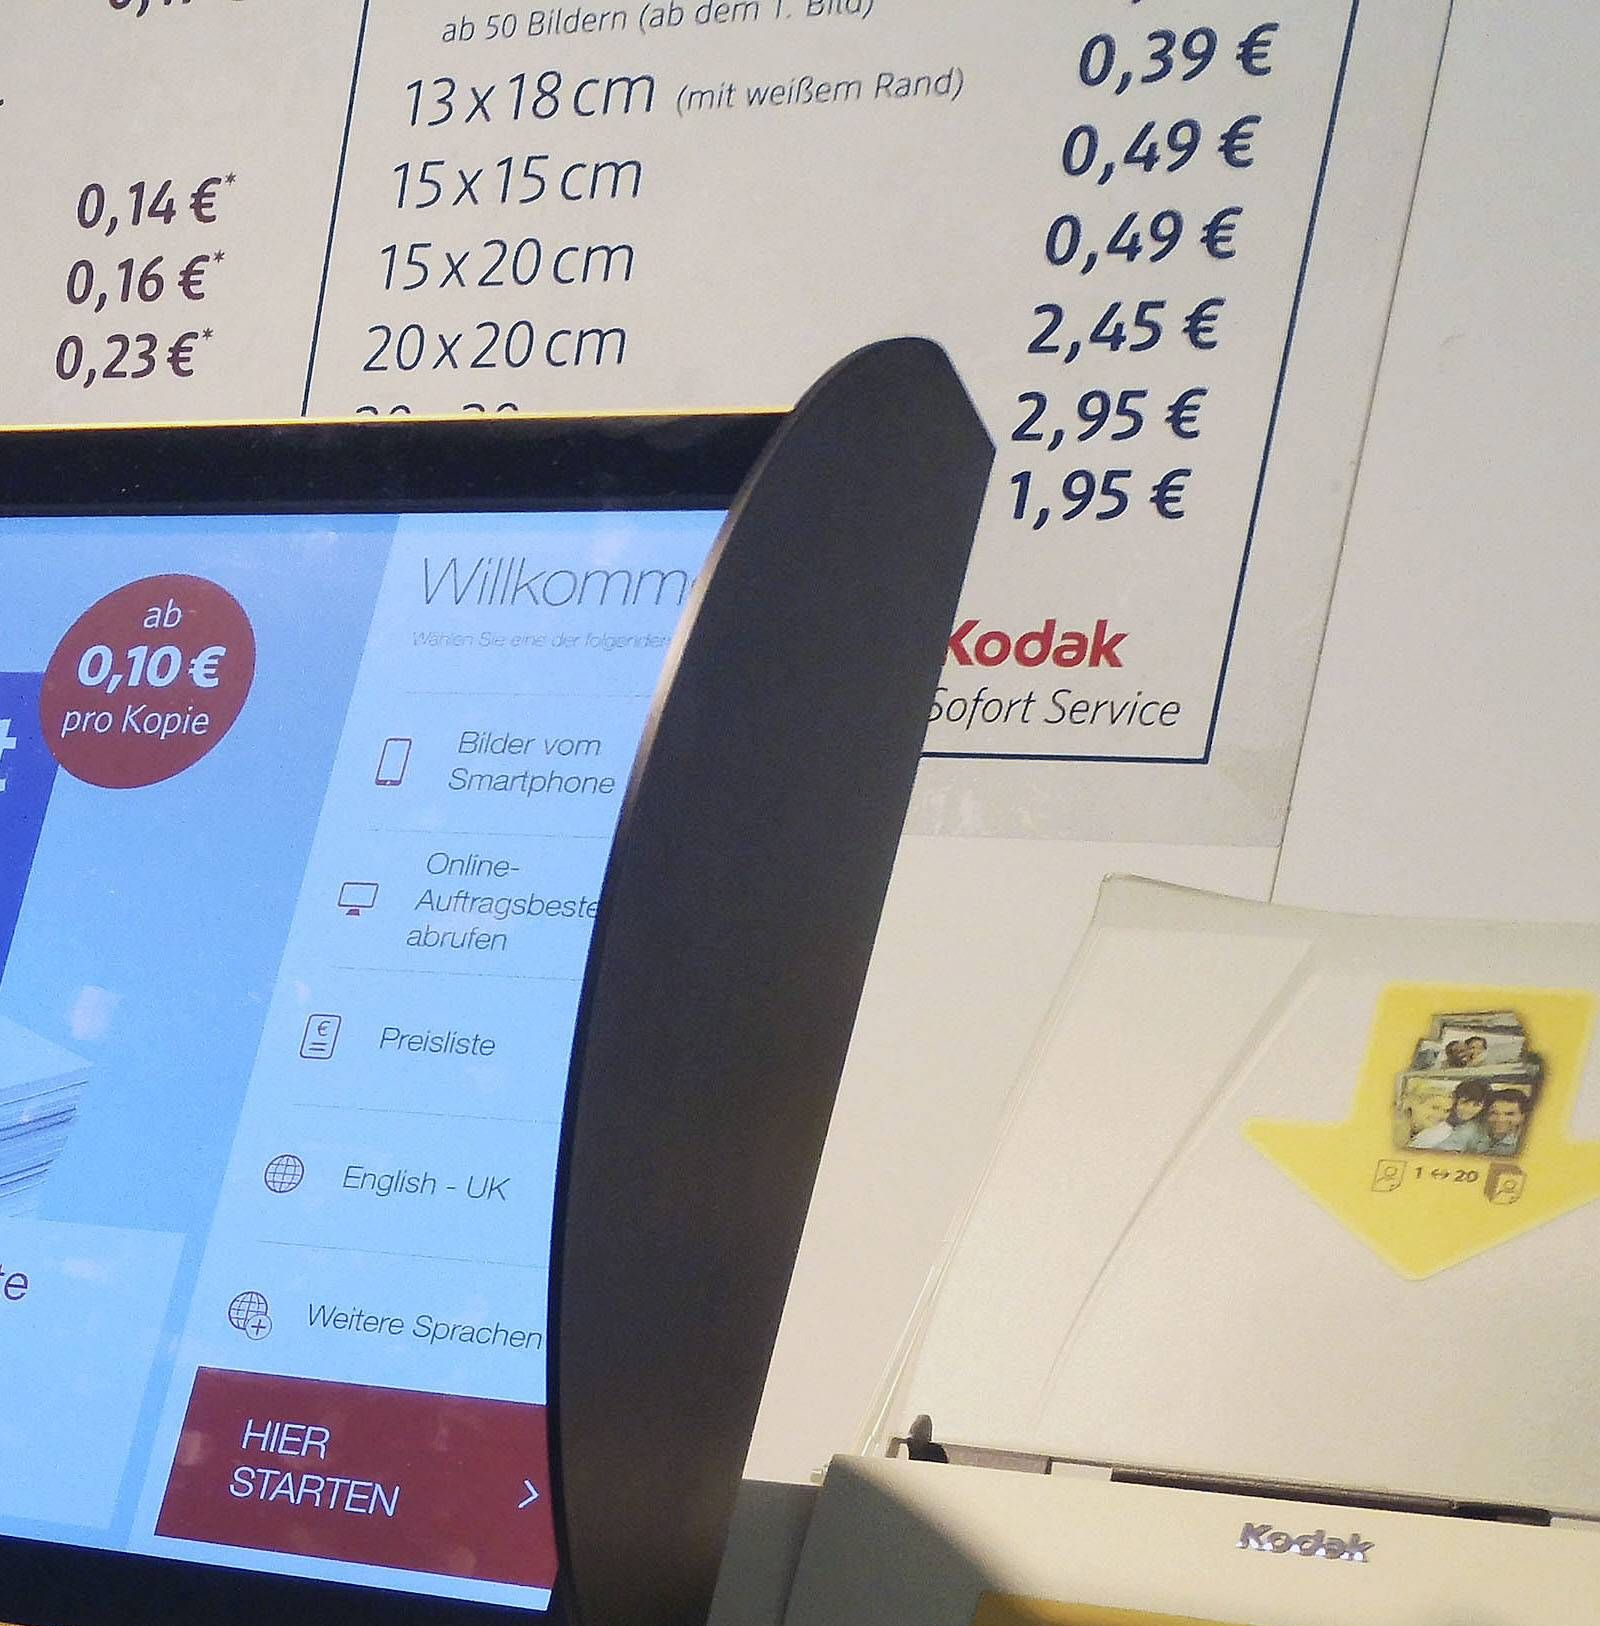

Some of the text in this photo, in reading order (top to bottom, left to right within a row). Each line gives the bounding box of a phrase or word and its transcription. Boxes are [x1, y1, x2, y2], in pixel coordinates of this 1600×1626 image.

[676, 67, 965, 113] (mit weißem Rand)
[422, 556, 699, 607] Willkomm
[142, 599, 182, 630] ab
[944, 617, 1128, 668] Kodak
[61, 707, 210, 741] pro Kopie
[927, 685, 1181, 733] Sofort Service
[458, 731, 601, 757] Bilder vom
[448, 768, 615, 798] Smartphone
[427, 853, 519, 879] Online-
[406, 926, 507, 952] abrufen
[379, 1026, 495, 1058] Preisliste
[343, 1166, 436, 1197] English
[466, 1178, 510, 1202] UK
[307, 1304, 543, 1351] Weitere Sprachen
[241, 1419, 331, 1459] HIER
[228, 1465, 399, 1518] STARTEN
[1236, 1522, 1375, 1562] Kodak
